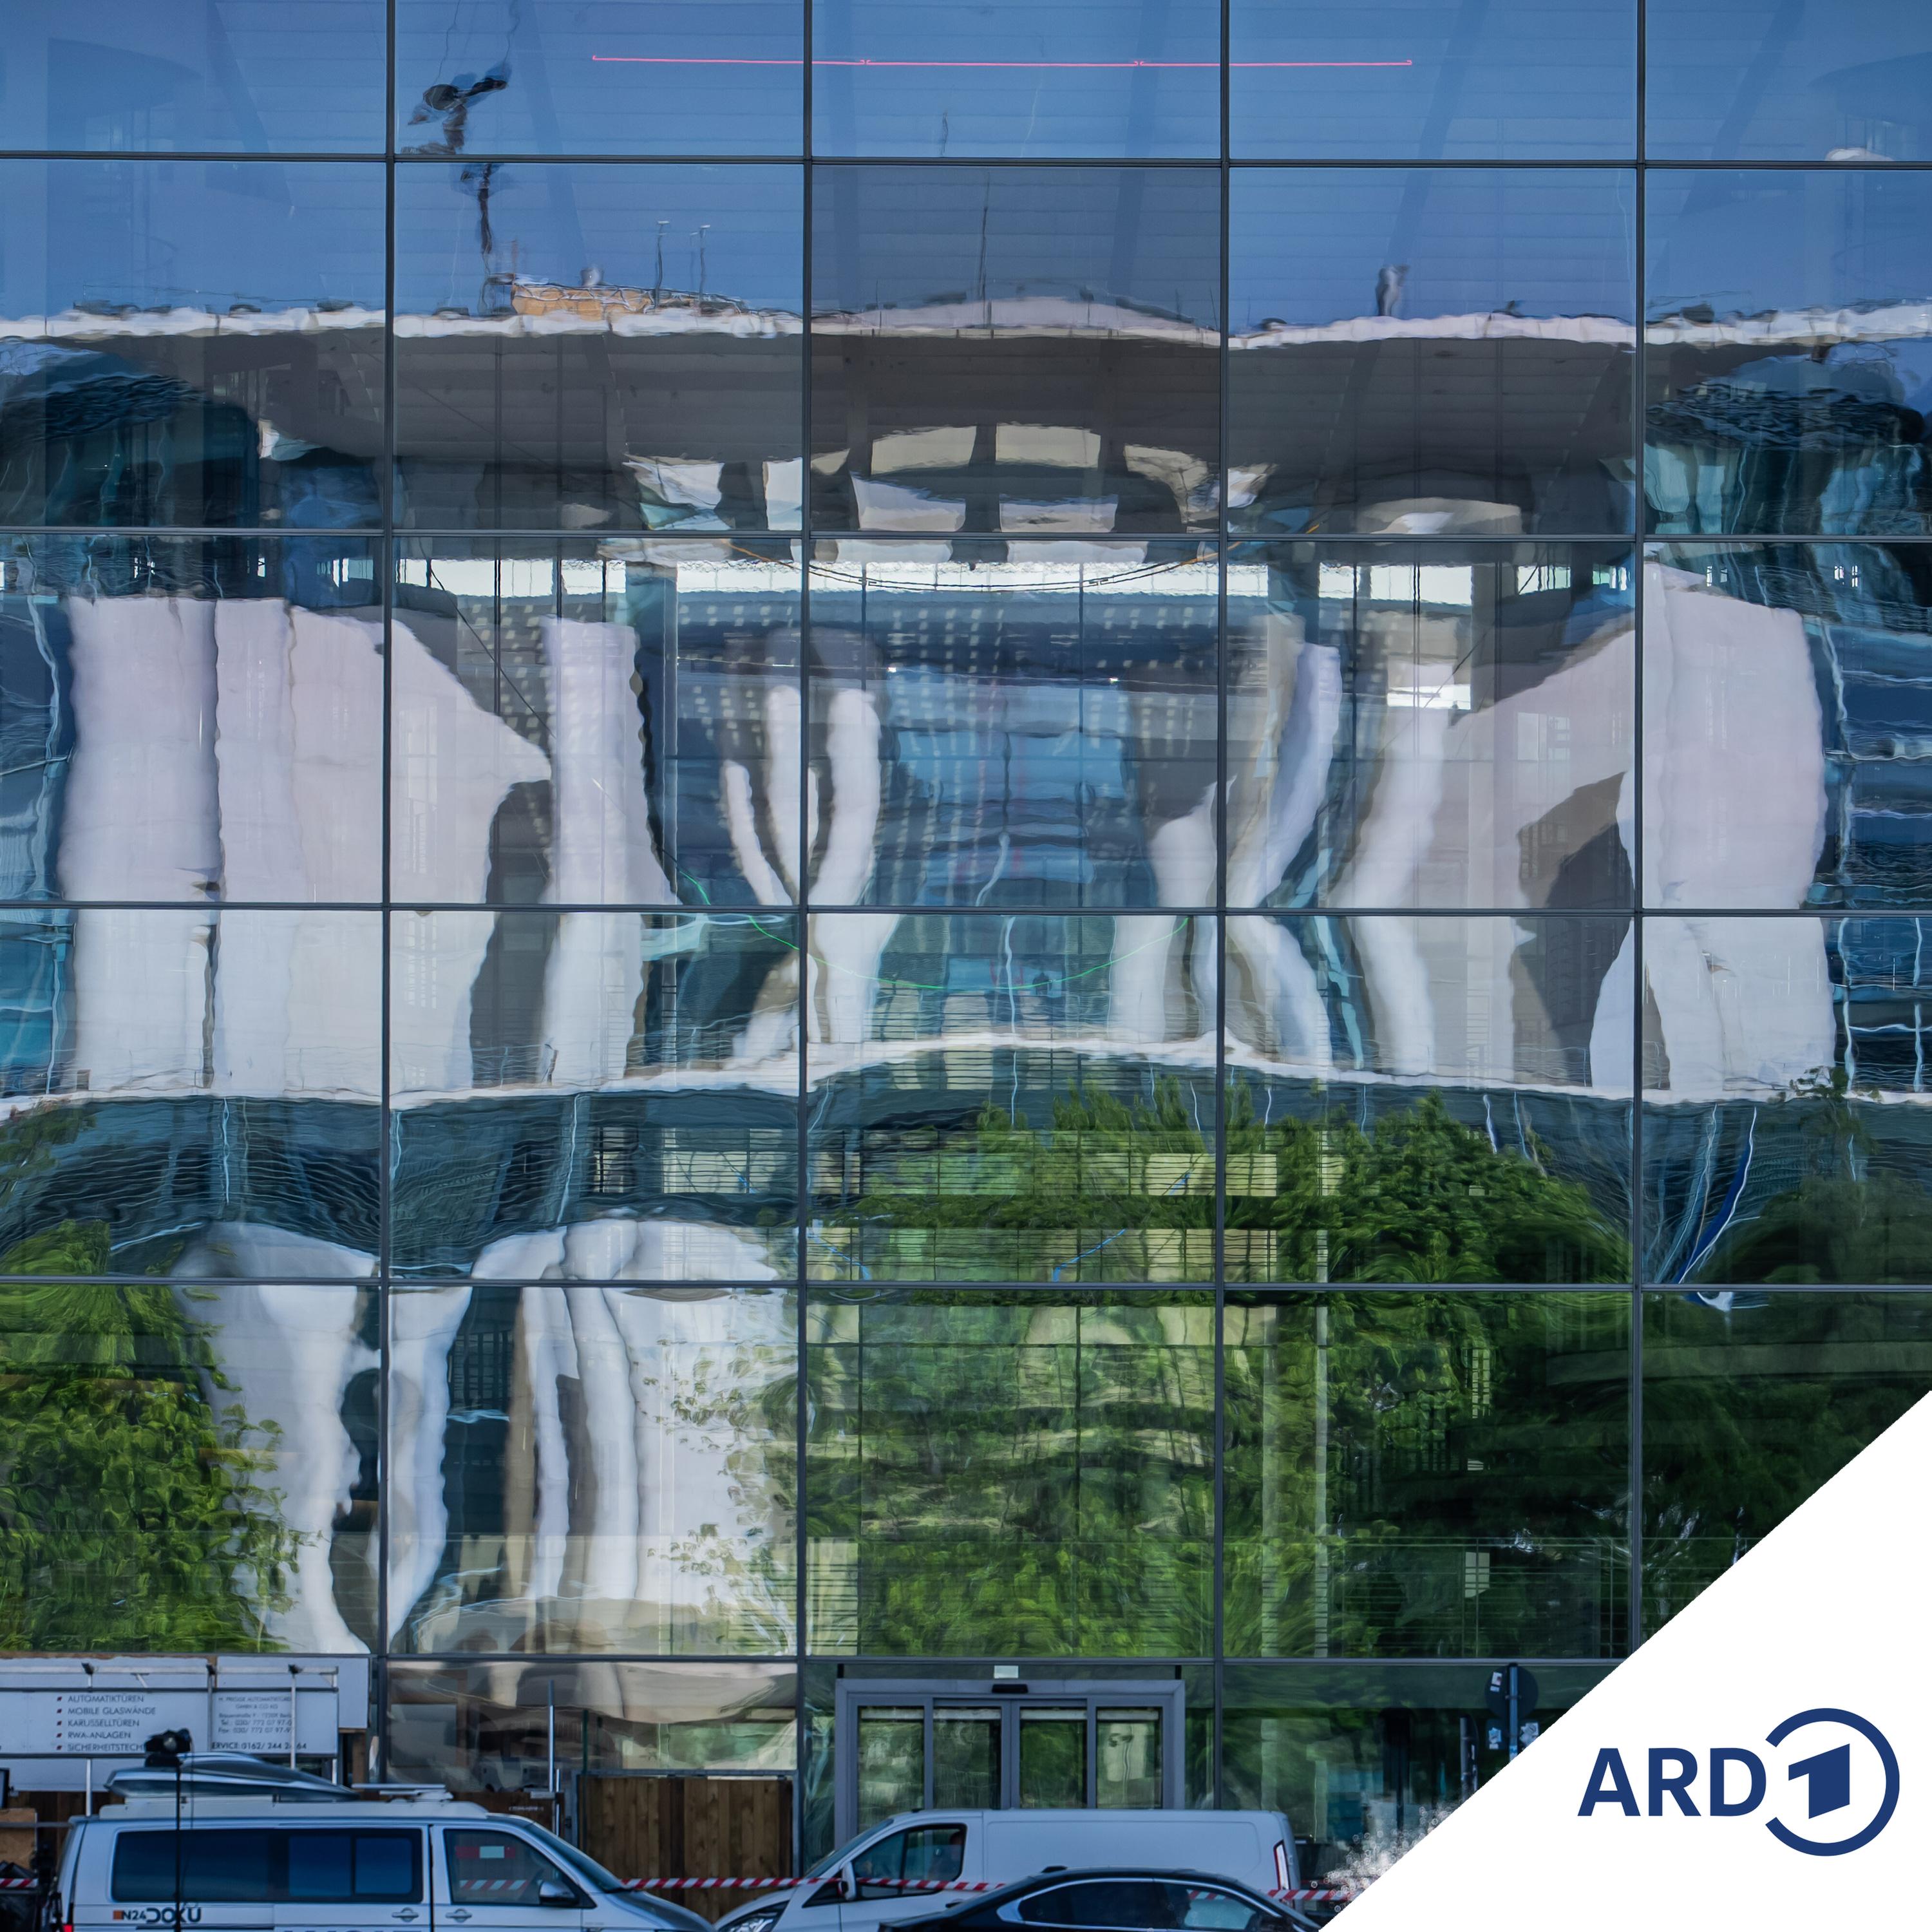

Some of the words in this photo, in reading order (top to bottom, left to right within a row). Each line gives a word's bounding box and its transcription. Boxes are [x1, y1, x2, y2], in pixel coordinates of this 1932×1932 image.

[68, 1694, 144, 1703] AUTOMATIKTÜREN
[68, 1707, 99, 1715] MOBILE
[102, 1706, 156, 1716] GLASWÄNDE
[68, 1718, 140, 1727] KARUSSELLTÜREN
[68, 1731, 131, 1739] RWA-ANLAGEN
[68, 1743, 144, 1752] SICHERHEITSTECH
[212, 1741, 238, 1750] ERVICE
[123, 1910, 146, 1920] N24
